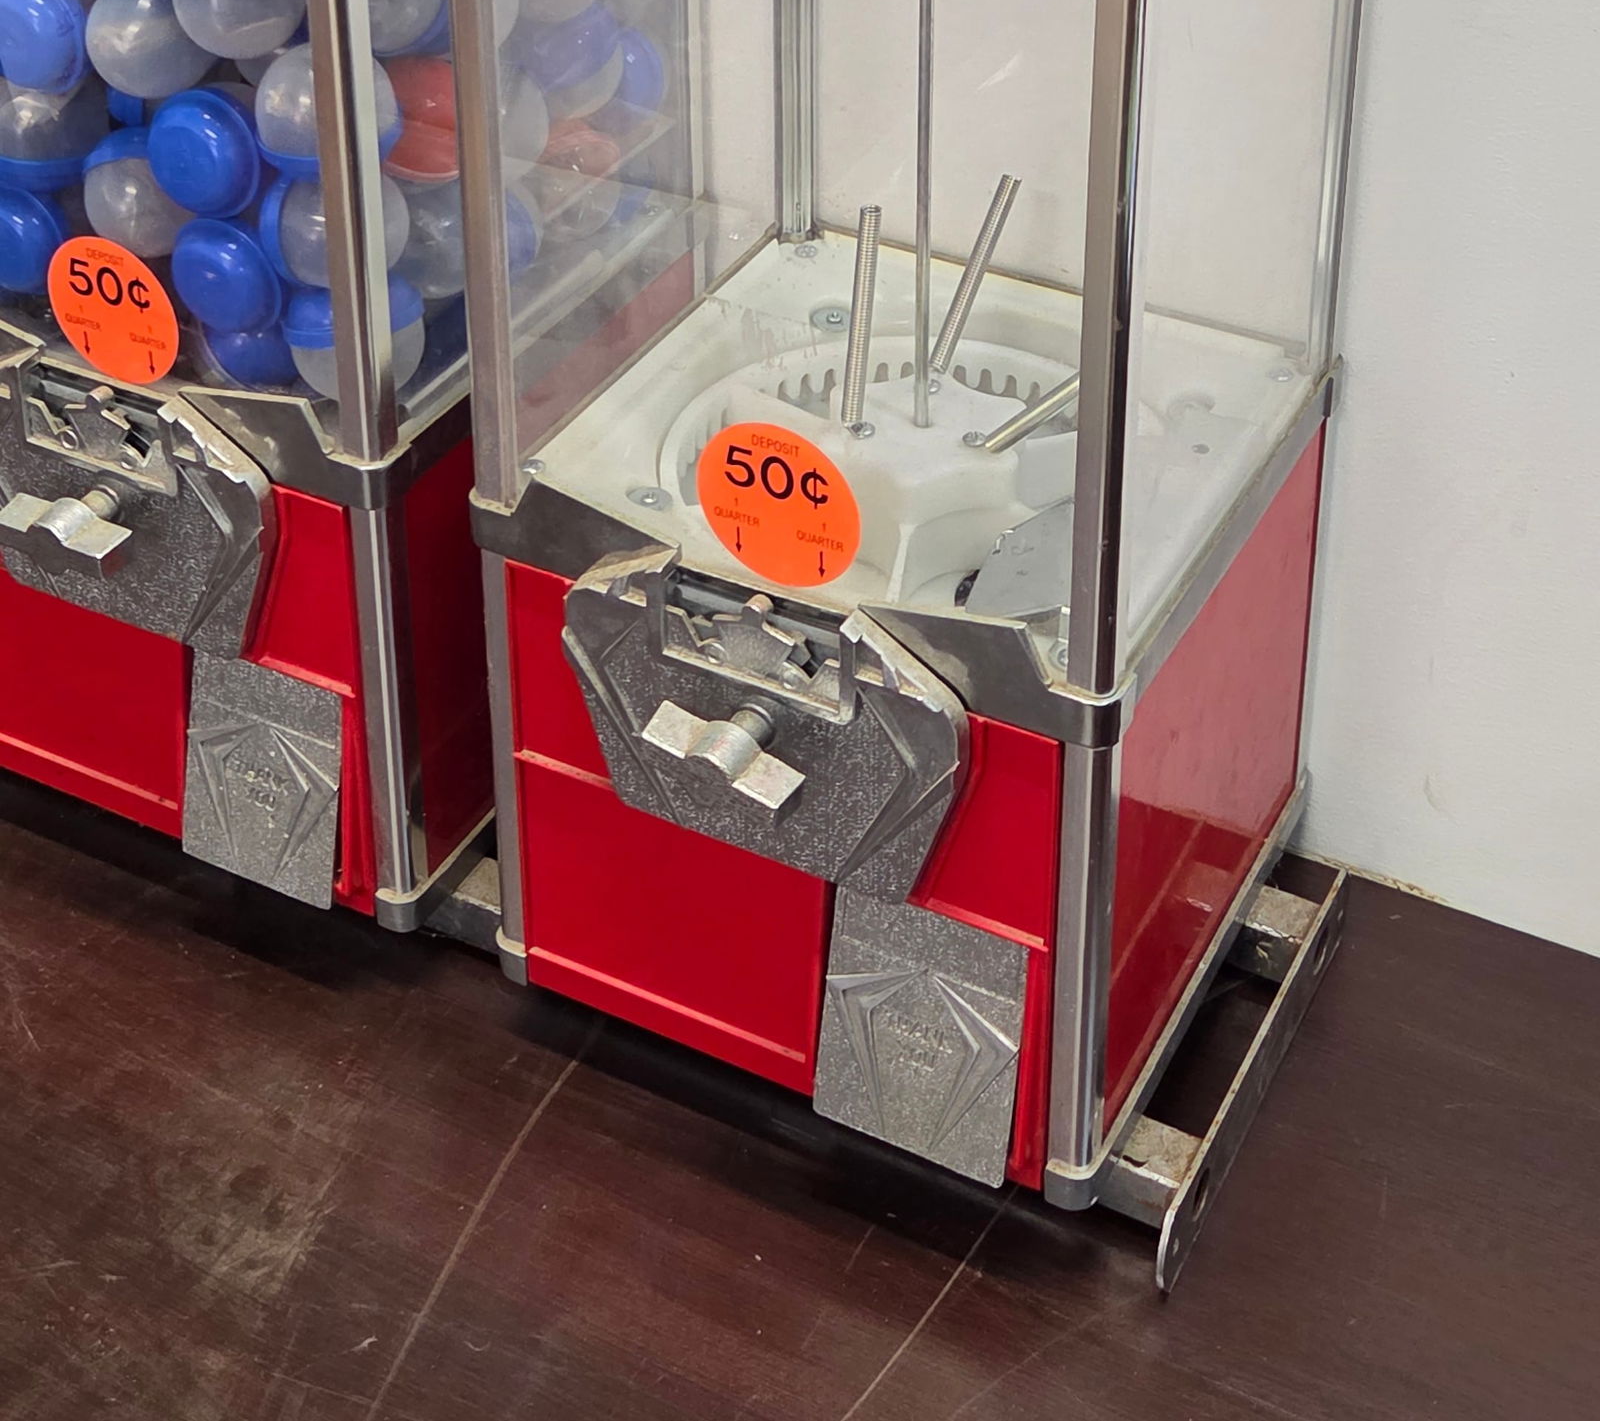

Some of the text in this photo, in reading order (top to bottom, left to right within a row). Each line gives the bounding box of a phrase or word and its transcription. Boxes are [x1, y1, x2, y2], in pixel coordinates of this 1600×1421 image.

[85, 247, 124, 267] DEPOSIT
[69, 257, 150, 313] 50¢
[64, 313, 102, 332] QUARTER
[129, 332, 167, 351] QUARTER
[751, 434, 800, 457] DEPOSIT
[724, 445, 829, 510] 50¢
[713, 506, 760, 527] QUARTER
[796, 530, 844, 552] QUARTER
